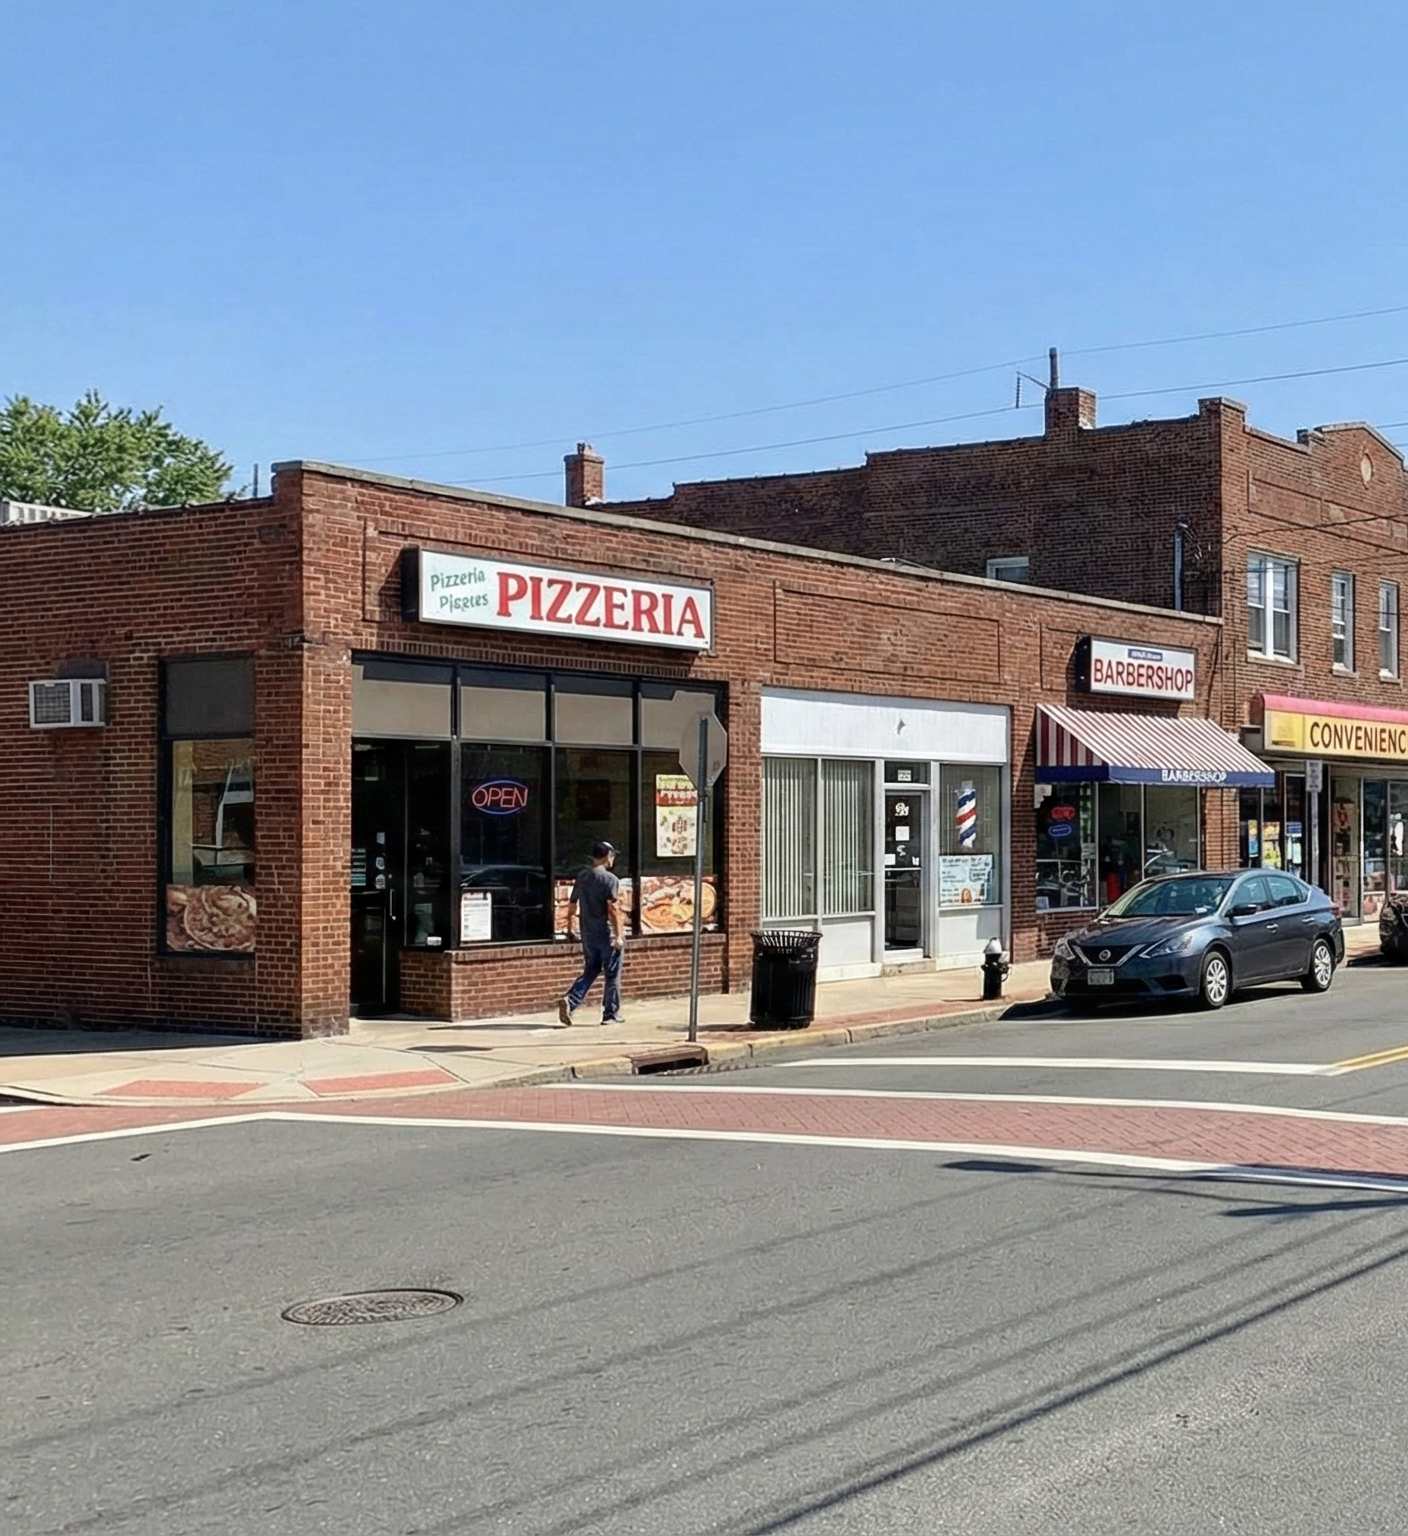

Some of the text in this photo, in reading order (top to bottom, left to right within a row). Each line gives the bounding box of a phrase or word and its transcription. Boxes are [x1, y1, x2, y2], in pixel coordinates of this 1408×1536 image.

[430, 566, 486, 592] Pizzeria
[496, 571, 706, 639] PIZZERIA
[1094, 658, 1193, 692] BARBERSHOP
[471, 786, 529, 808] OPEN
